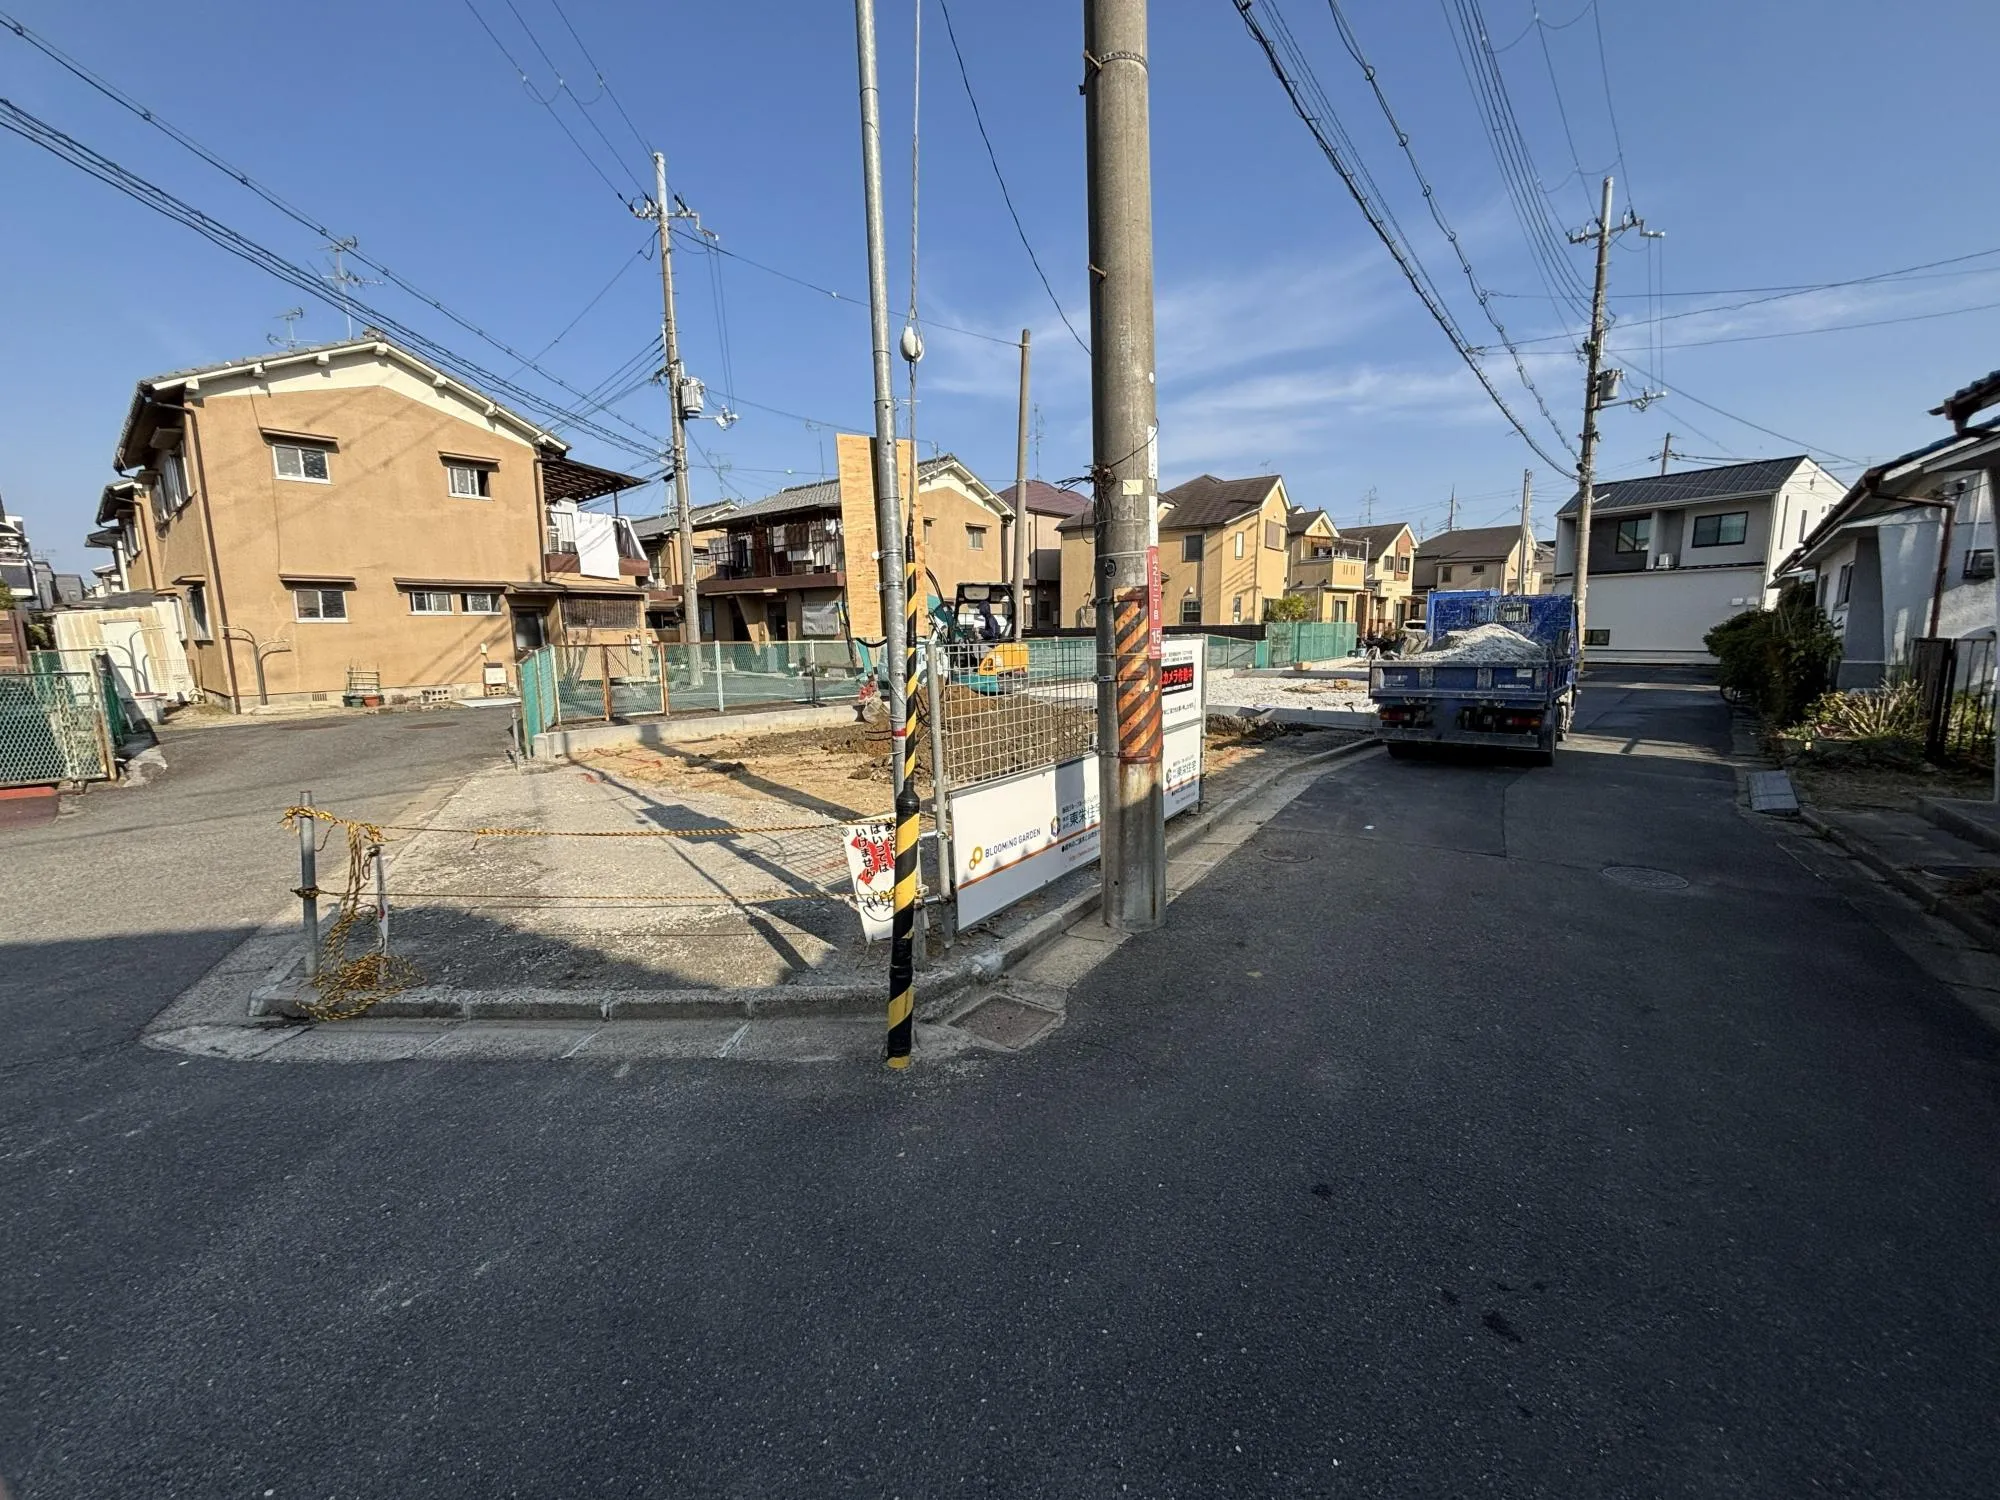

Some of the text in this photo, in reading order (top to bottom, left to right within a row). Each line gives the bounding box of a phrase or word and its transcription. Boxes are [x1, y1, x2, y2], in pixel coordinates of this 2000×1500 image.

[1151, 630, 1160, 644] 15
[1161, 667, 1193, 684] カメラ作動中
[856, 828, 875, 878] いけません
[870, 825, 889, 873] はいっては
[985, 837, 1017, 858] BLOOMING
[1018, 827, 1041, 844] GARDEN
